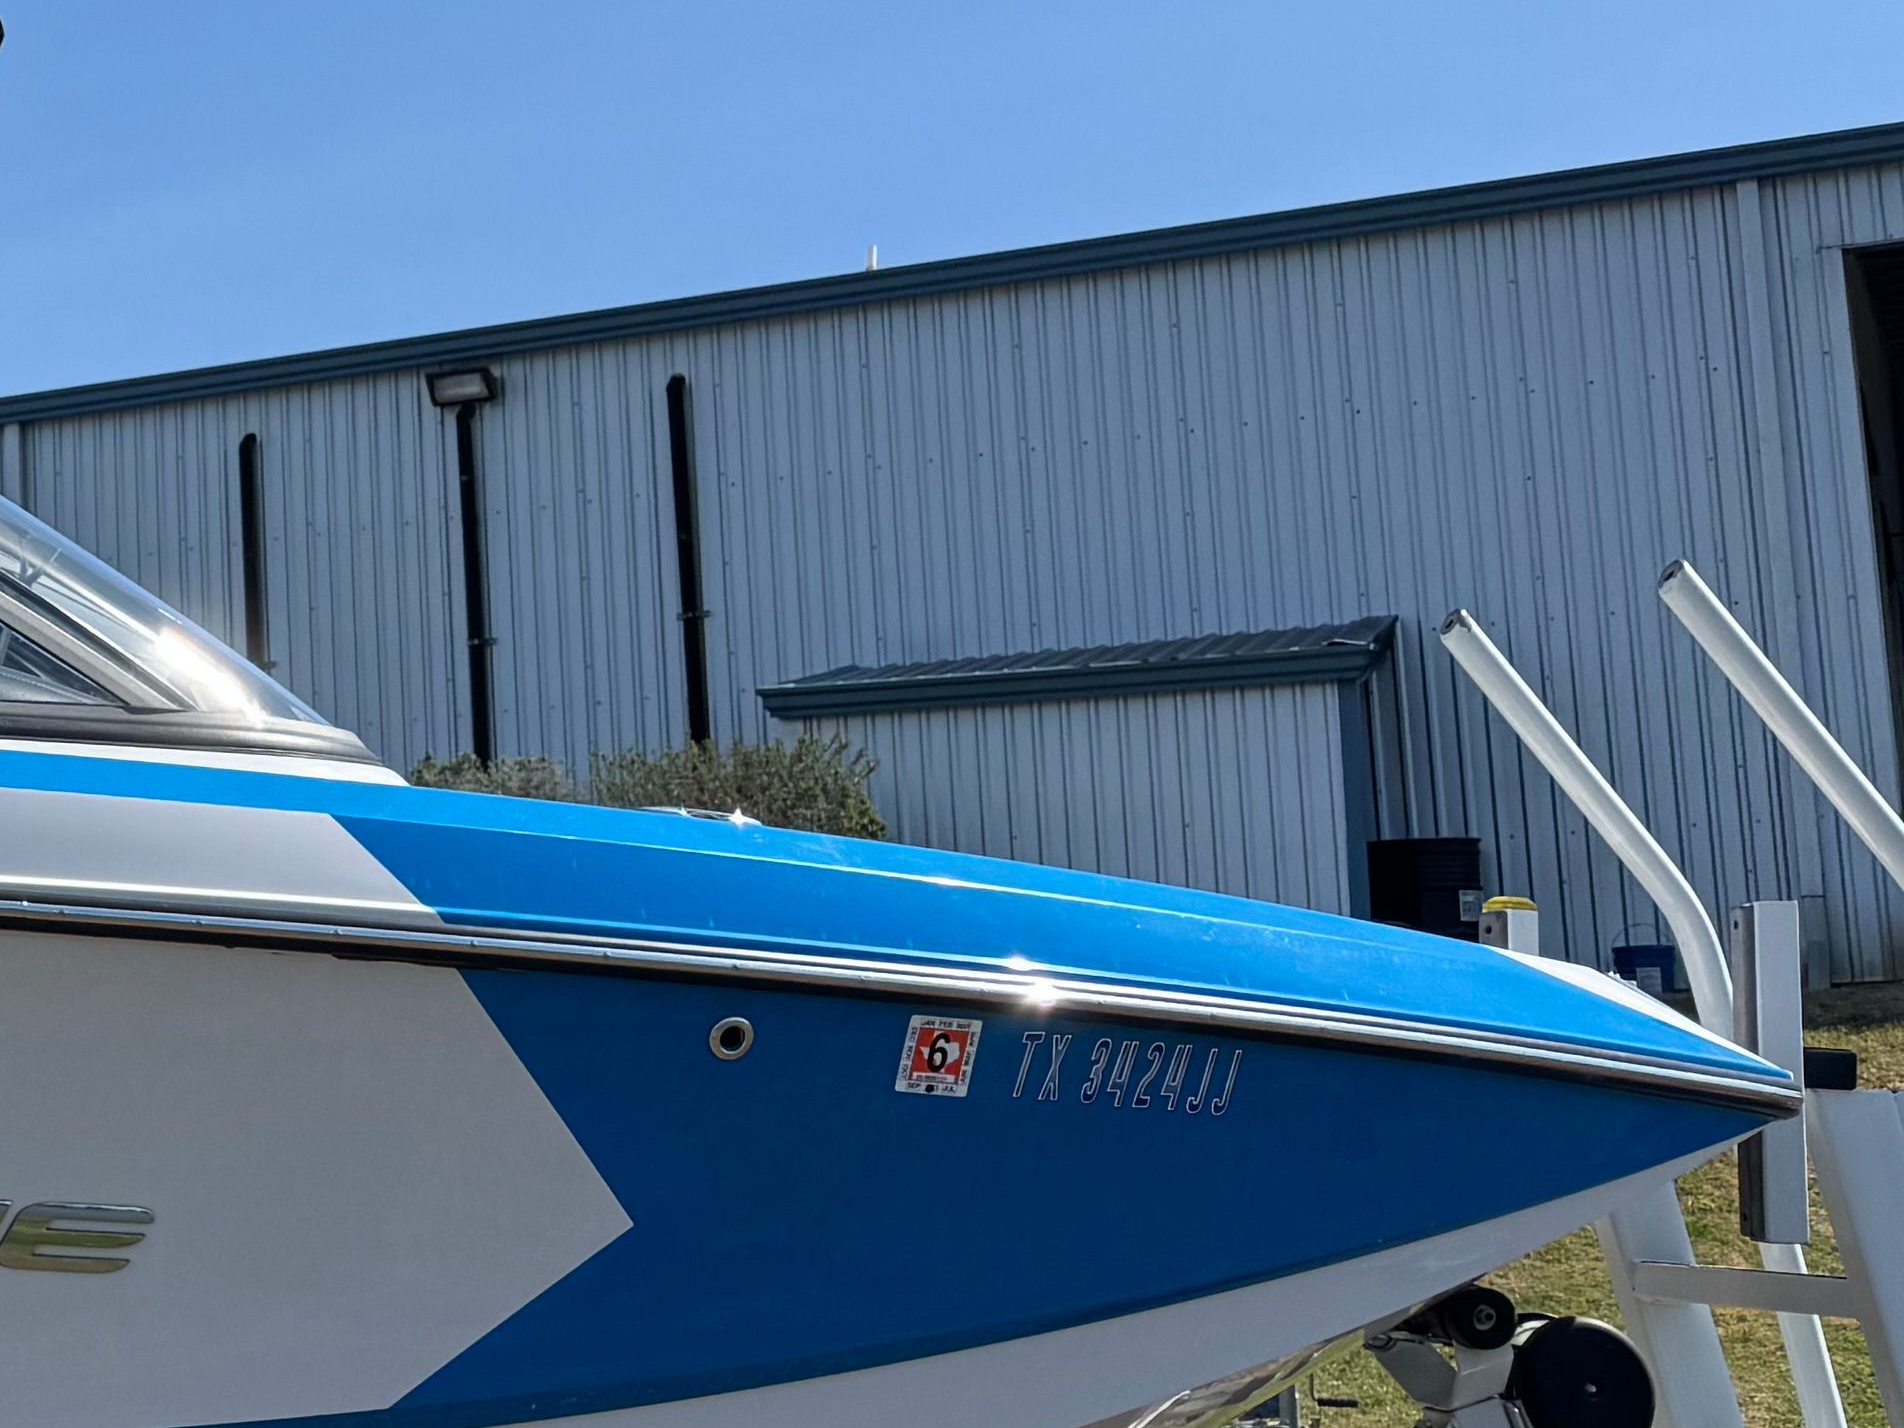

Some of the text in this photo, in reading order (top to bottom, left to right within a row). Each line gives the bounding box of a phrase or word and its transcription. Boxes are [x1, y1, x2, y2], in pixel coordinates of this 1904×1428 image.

[927, 1032, 951, 1073] 6
[1012, 1031, 1072, 1100] TX
[1080, 1038, 1243, 1116] 3424JJ
